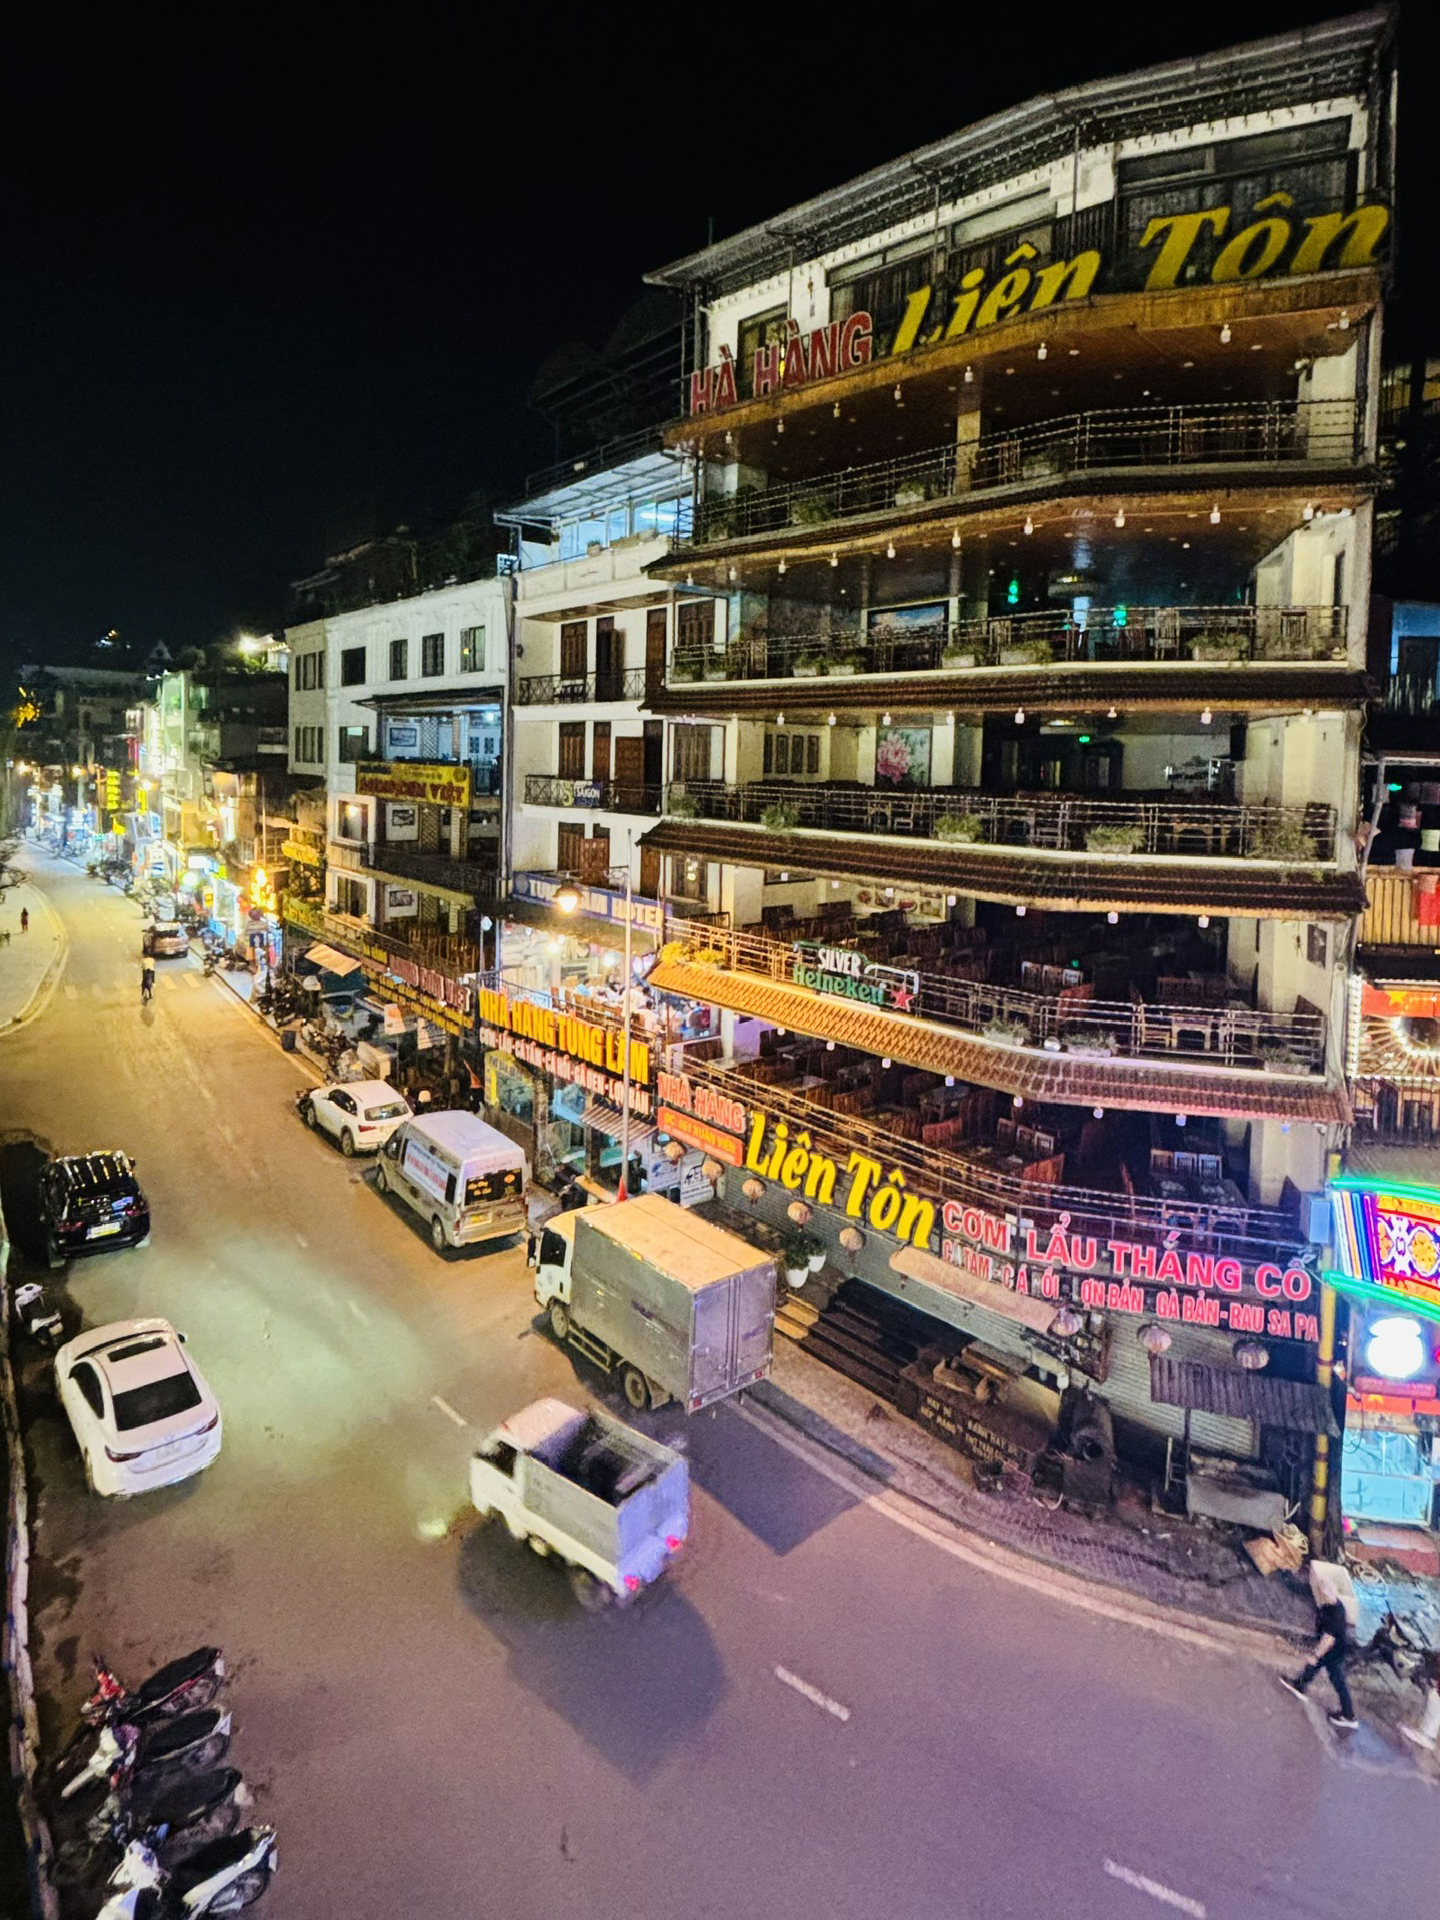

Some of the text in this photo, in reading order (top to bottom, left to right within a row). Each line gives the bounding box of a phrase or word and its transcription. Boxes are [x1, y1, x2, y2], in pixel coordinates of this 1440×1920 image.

[891, 192, 1389, 356] Liên Tôn
[753, 311, 873, 399] HÀNG
[792, 963, 885, 1005] Heineken
[818, 948, 861, 979] SILVER
[479, 985, 511, 1030] NHÀ
[512, 996, 556, 1048] HÀNG
[557, 1009, 606, 1067] TÙNG
[606, 1029, 650, 1086] LÂM
[657, 1071, 746, 1134] NHÀ HÀNG
[746, 1111, 935, 1249] Liên Tôn
[942, 1200, 1011, 1254] CƠM
[1026, 1211, 1097, 1270] LẨU
[1107, 1277, 1143, 1313] BẢN
[1156, 1287, 1180, 1320] GÀ
[1268, 1309, 1292, 1338] SA
[1295, 1313, 1320, 1343] PA
